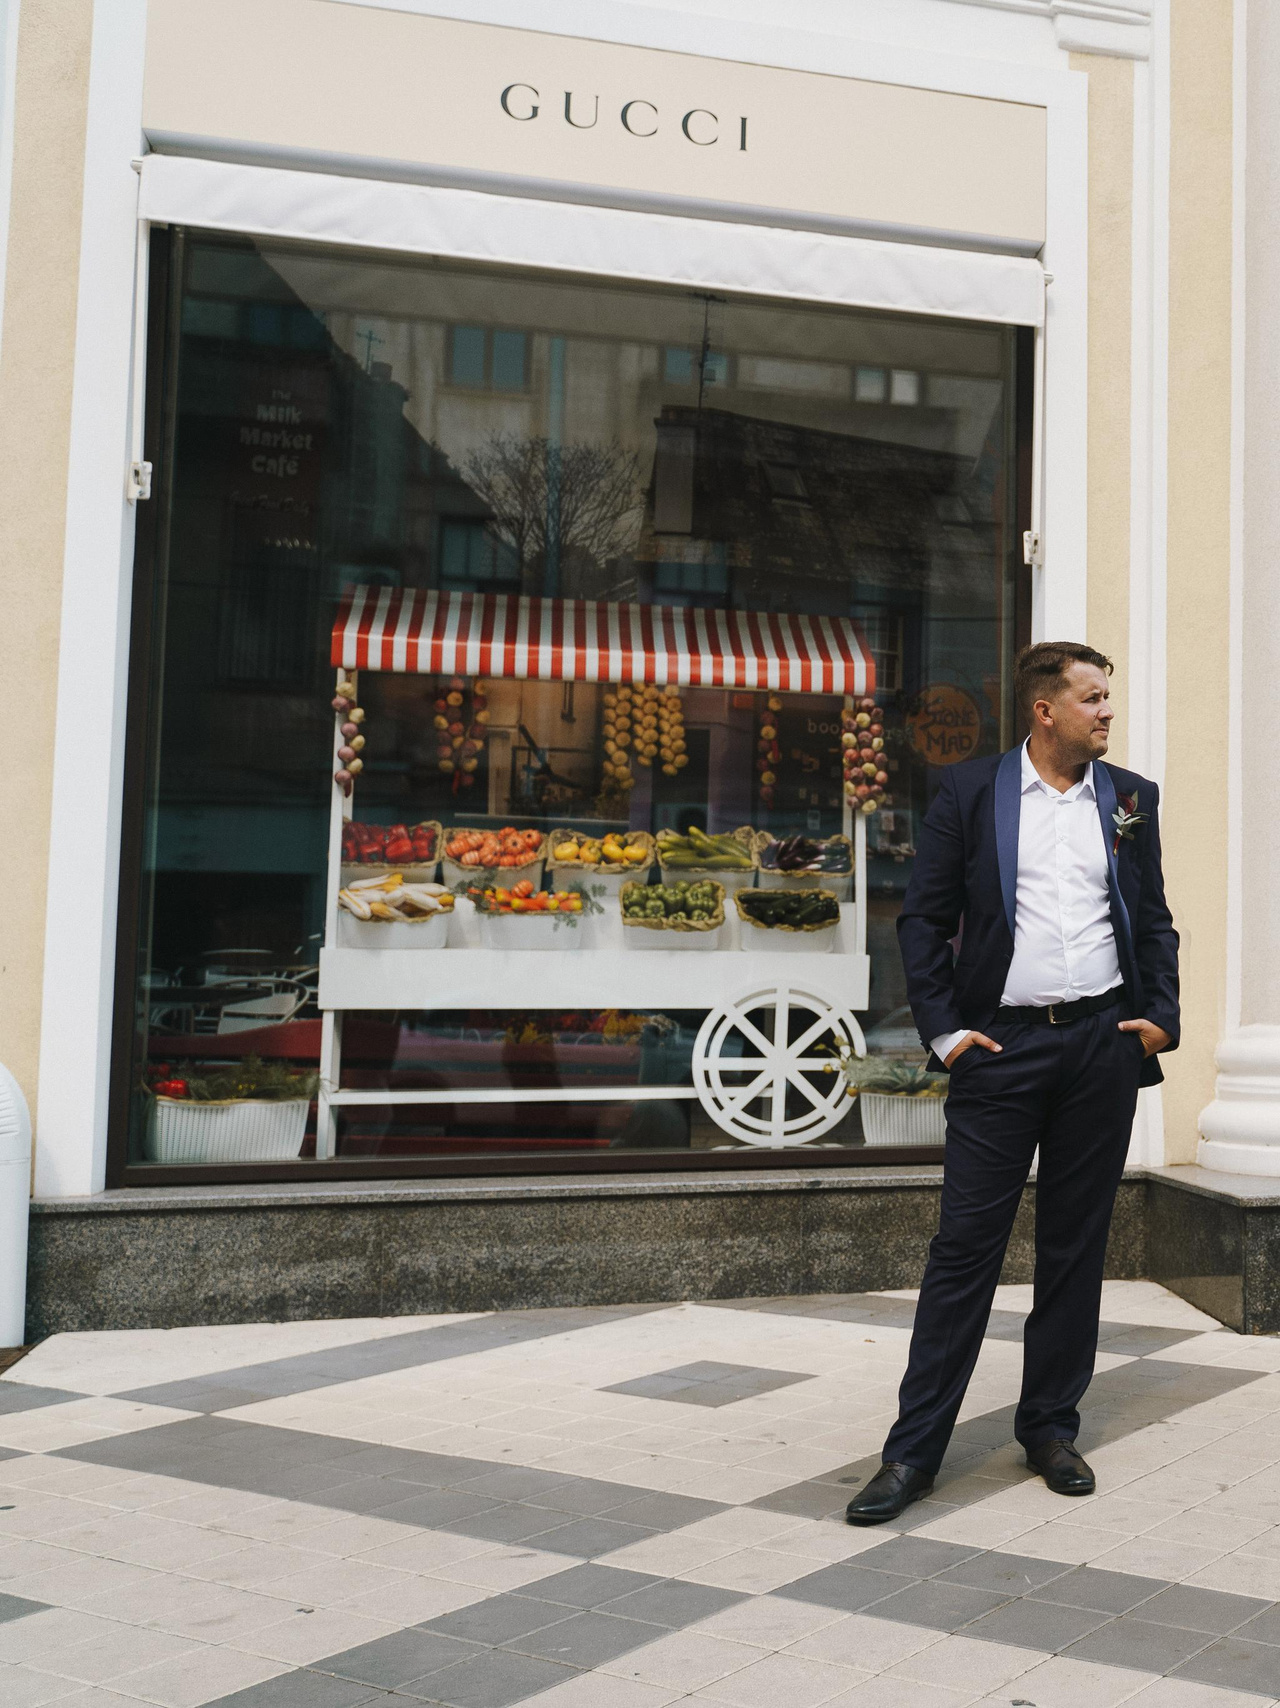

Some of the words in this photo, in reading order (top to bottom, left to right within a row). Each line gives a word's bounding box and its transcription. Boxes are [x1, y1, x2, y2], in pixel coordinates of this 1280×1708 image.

[500, 83, 747, 151] GUCCI
[256, 404, 302, 424] Milk
[240, 426, 313, 451] Market
